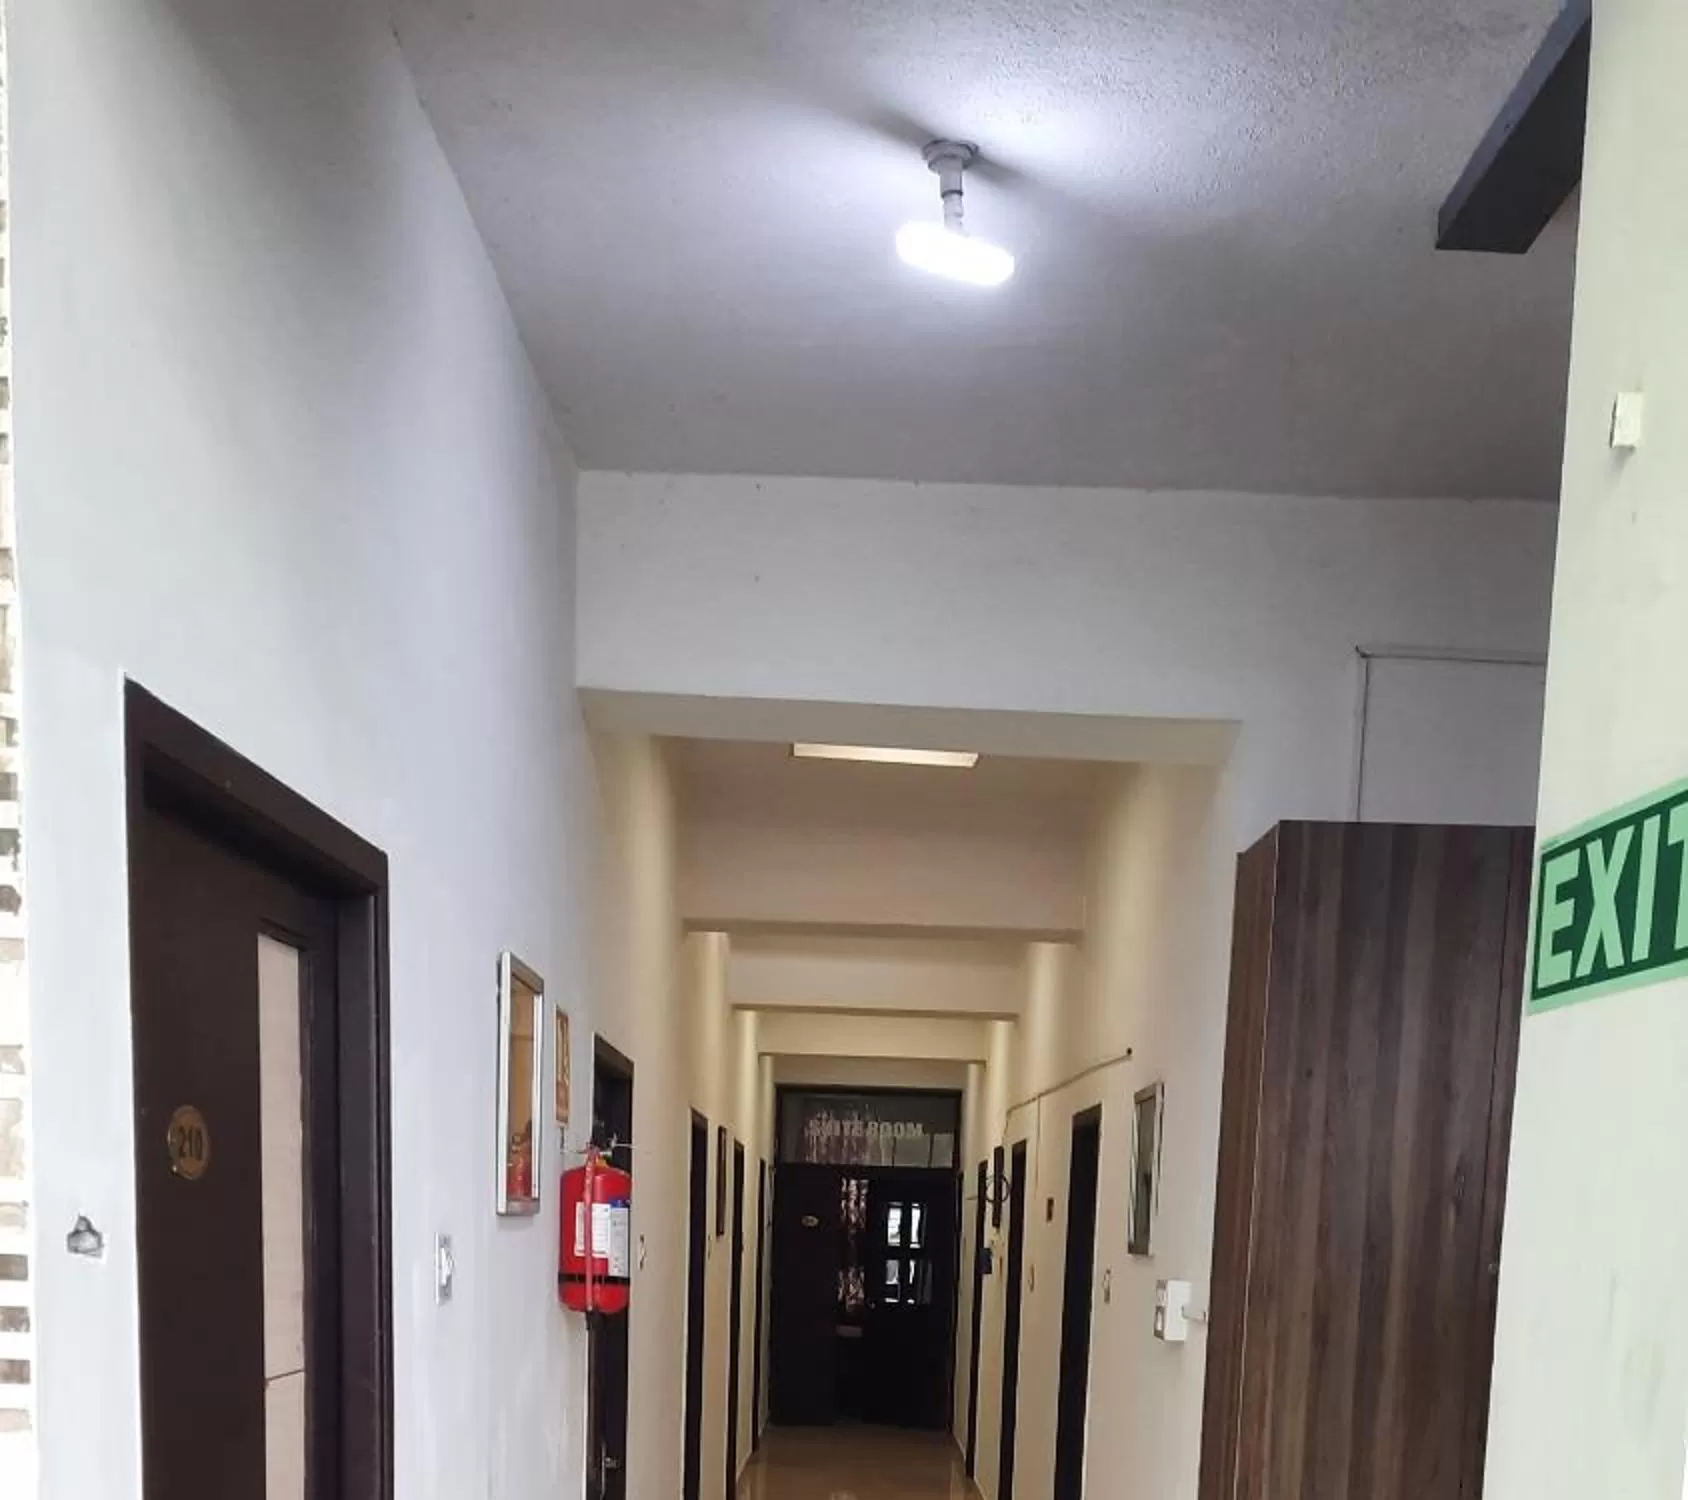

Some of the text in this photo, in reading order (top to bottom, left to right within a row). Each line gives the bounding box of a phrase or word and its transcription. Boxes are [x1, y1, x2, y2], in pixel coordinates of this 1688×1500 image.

[1537, 801, 1688, 989] EXIT
[178, 1125, 203, 1161] 210
[866, 1120, 924, 1138] ROOM
